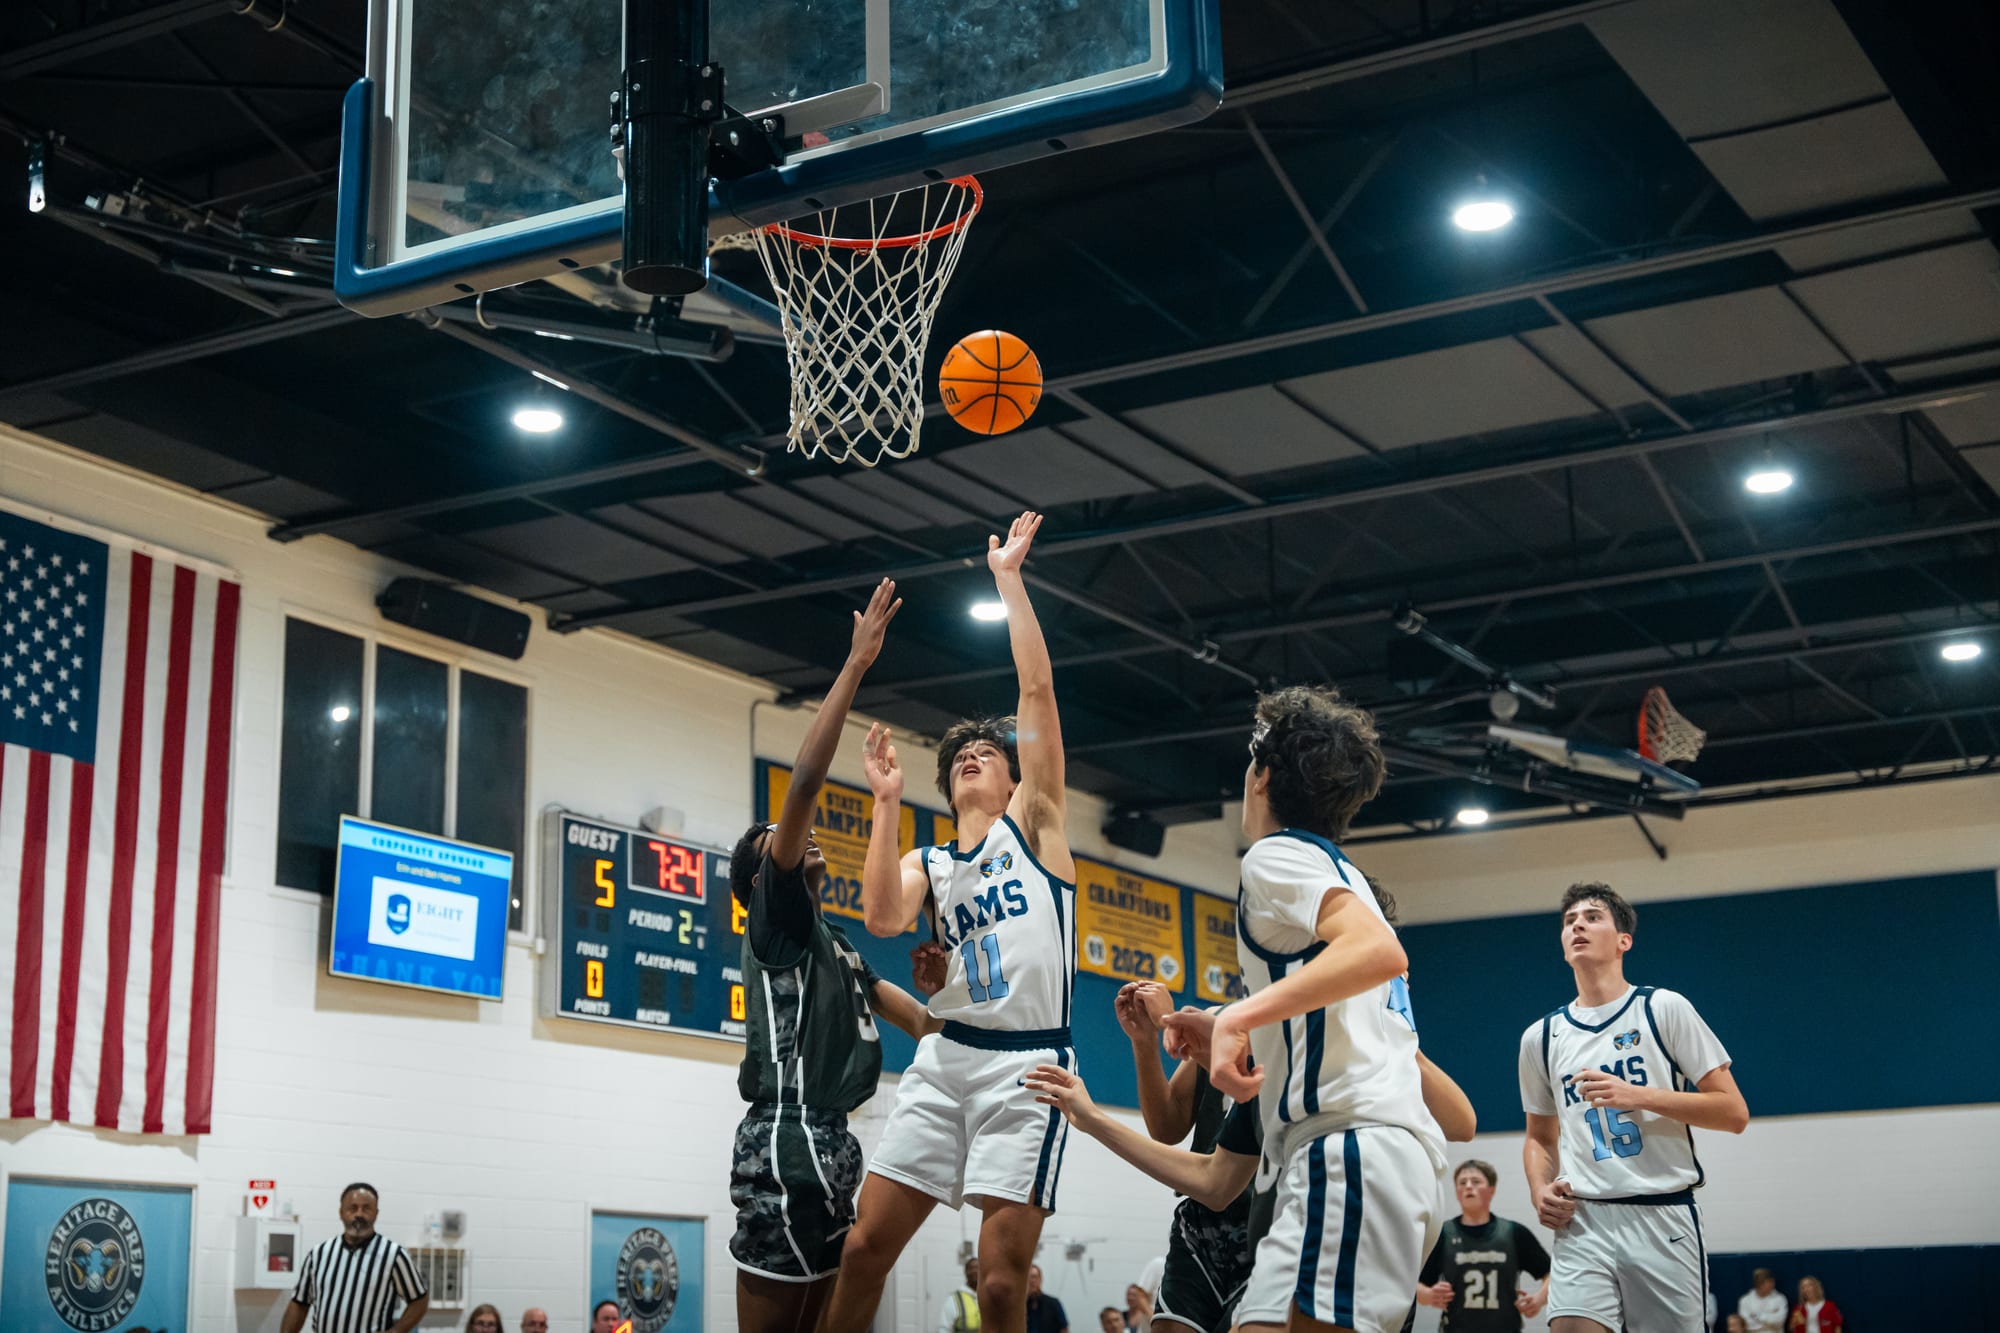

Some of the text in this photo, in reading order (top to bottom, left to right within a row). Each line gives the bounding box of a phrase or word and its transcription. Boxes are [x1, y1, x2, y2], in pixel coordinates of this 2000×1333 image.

[567, 823, 621, 853] GUEST
[594, 858, 616, 909] 5
[648, 840, 703, 897] 7:24
[821, 873, 864, 913] 202
[628, 908, 673, 932] PERIOD
[678, 909, 692, 945] 2
[576, 940, 609, 959] FOULS
[634, 951, 699, 975] PLAYER-FOUL
[960, 933, 1009, 1003] 11
[574, 998, 611, 1016] POINTS
[1561, 1055, 1648, 1108] RMS
[1584, 1105, 1644, 1162] 15
[47, 1200, 144, 1279] HERITAGE PREP
[48, 1286, 137, 1331] ATHLETICS
[1463, 1269, 1500, 1309] 21
